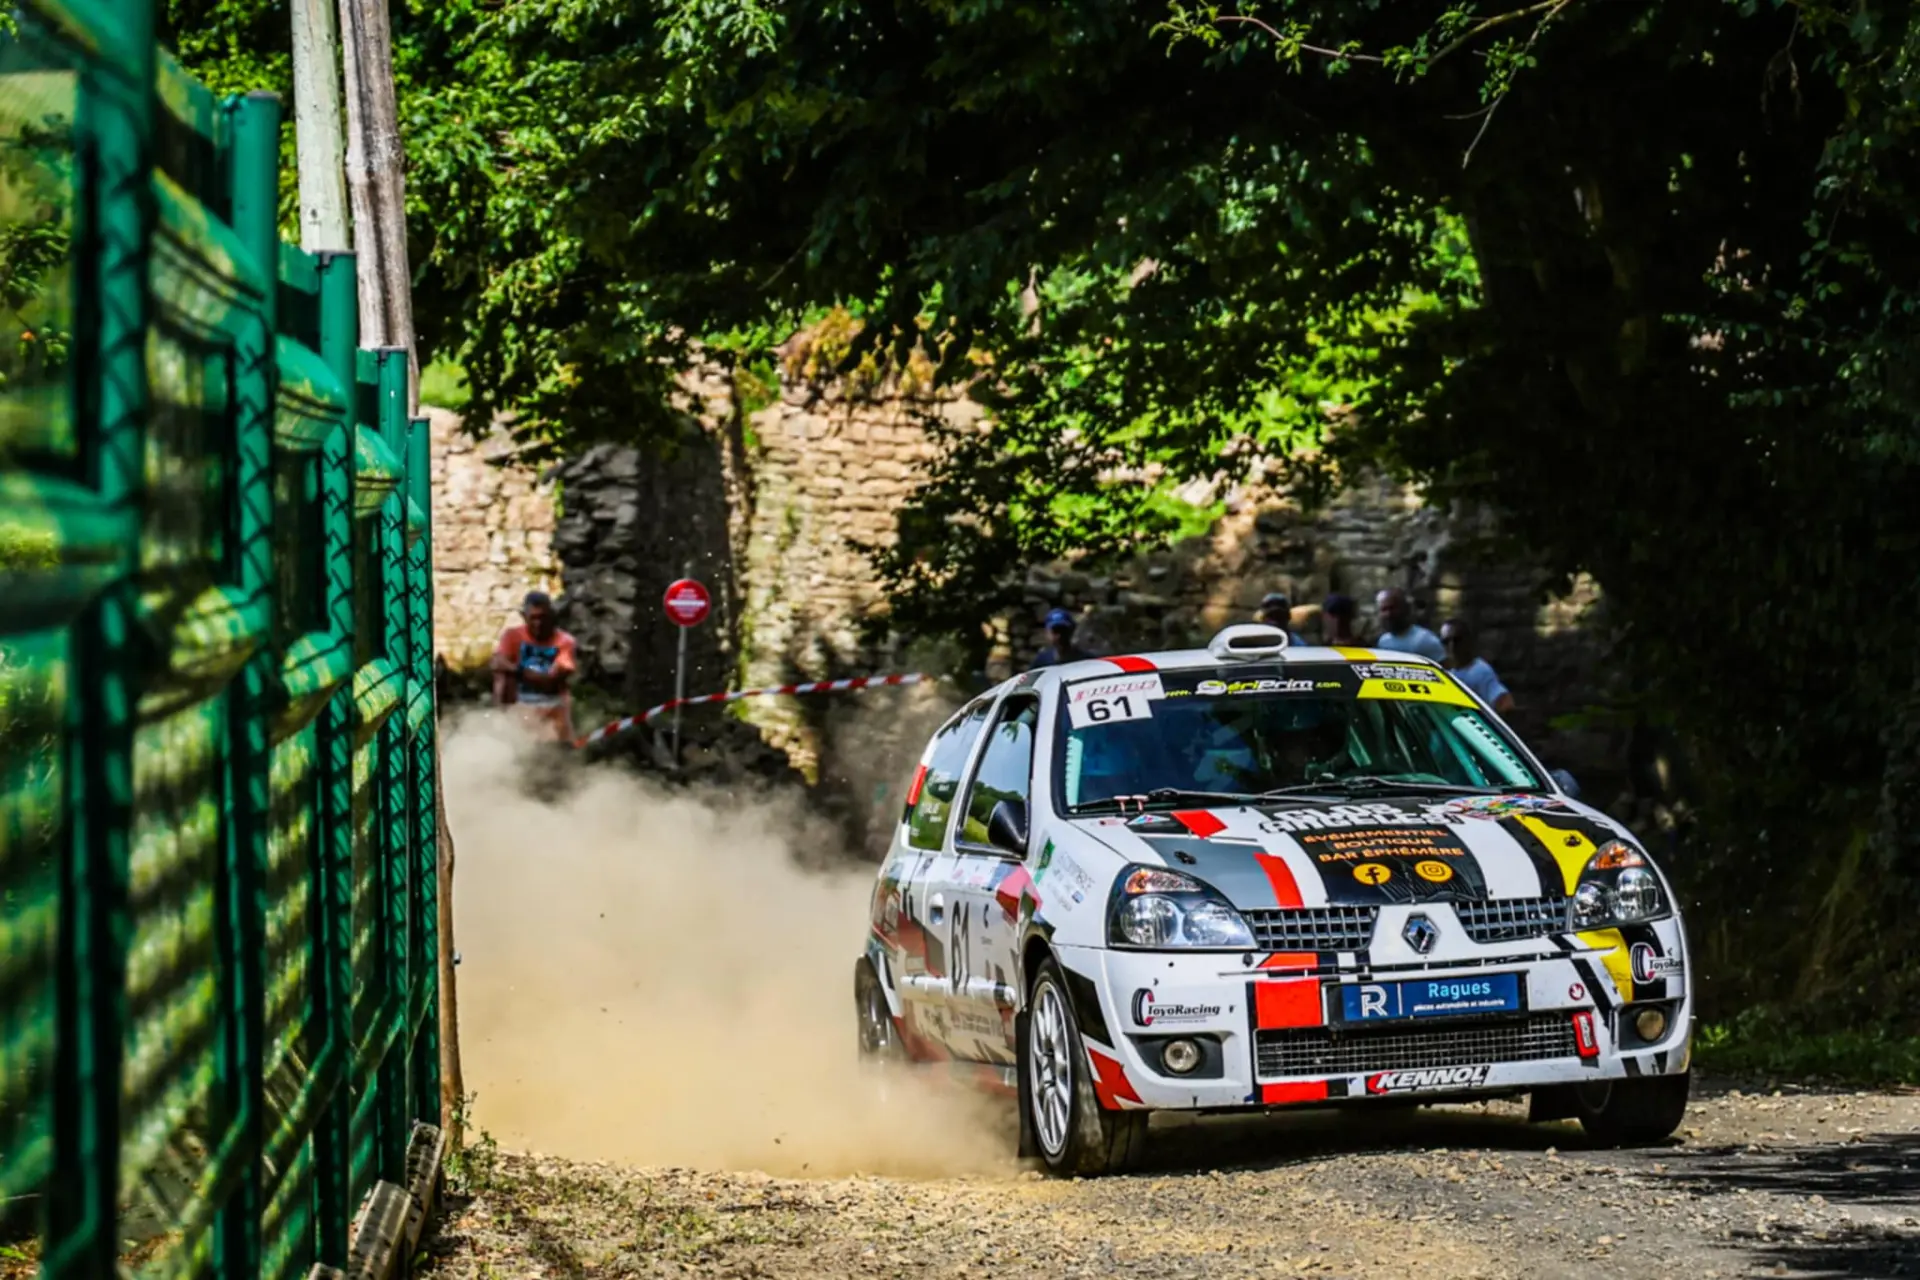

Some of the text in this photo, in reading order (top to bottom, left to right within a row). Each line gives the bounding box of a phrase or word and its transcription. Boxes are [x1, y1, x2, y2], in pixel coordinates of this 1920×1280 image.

[1087, 696, 1132, 722] 61
[1333, 837, 1434, 850] BOUTIQUE
[1318, 850, 1359, 862] BAR
[951, 900, 970, 995] 61
[1428, 982, 1491, 999] Ragues
[1148, 1003, 1221, 1017] ToyoRacing
[1376, 1066, 1484, 1089] KENNOL
